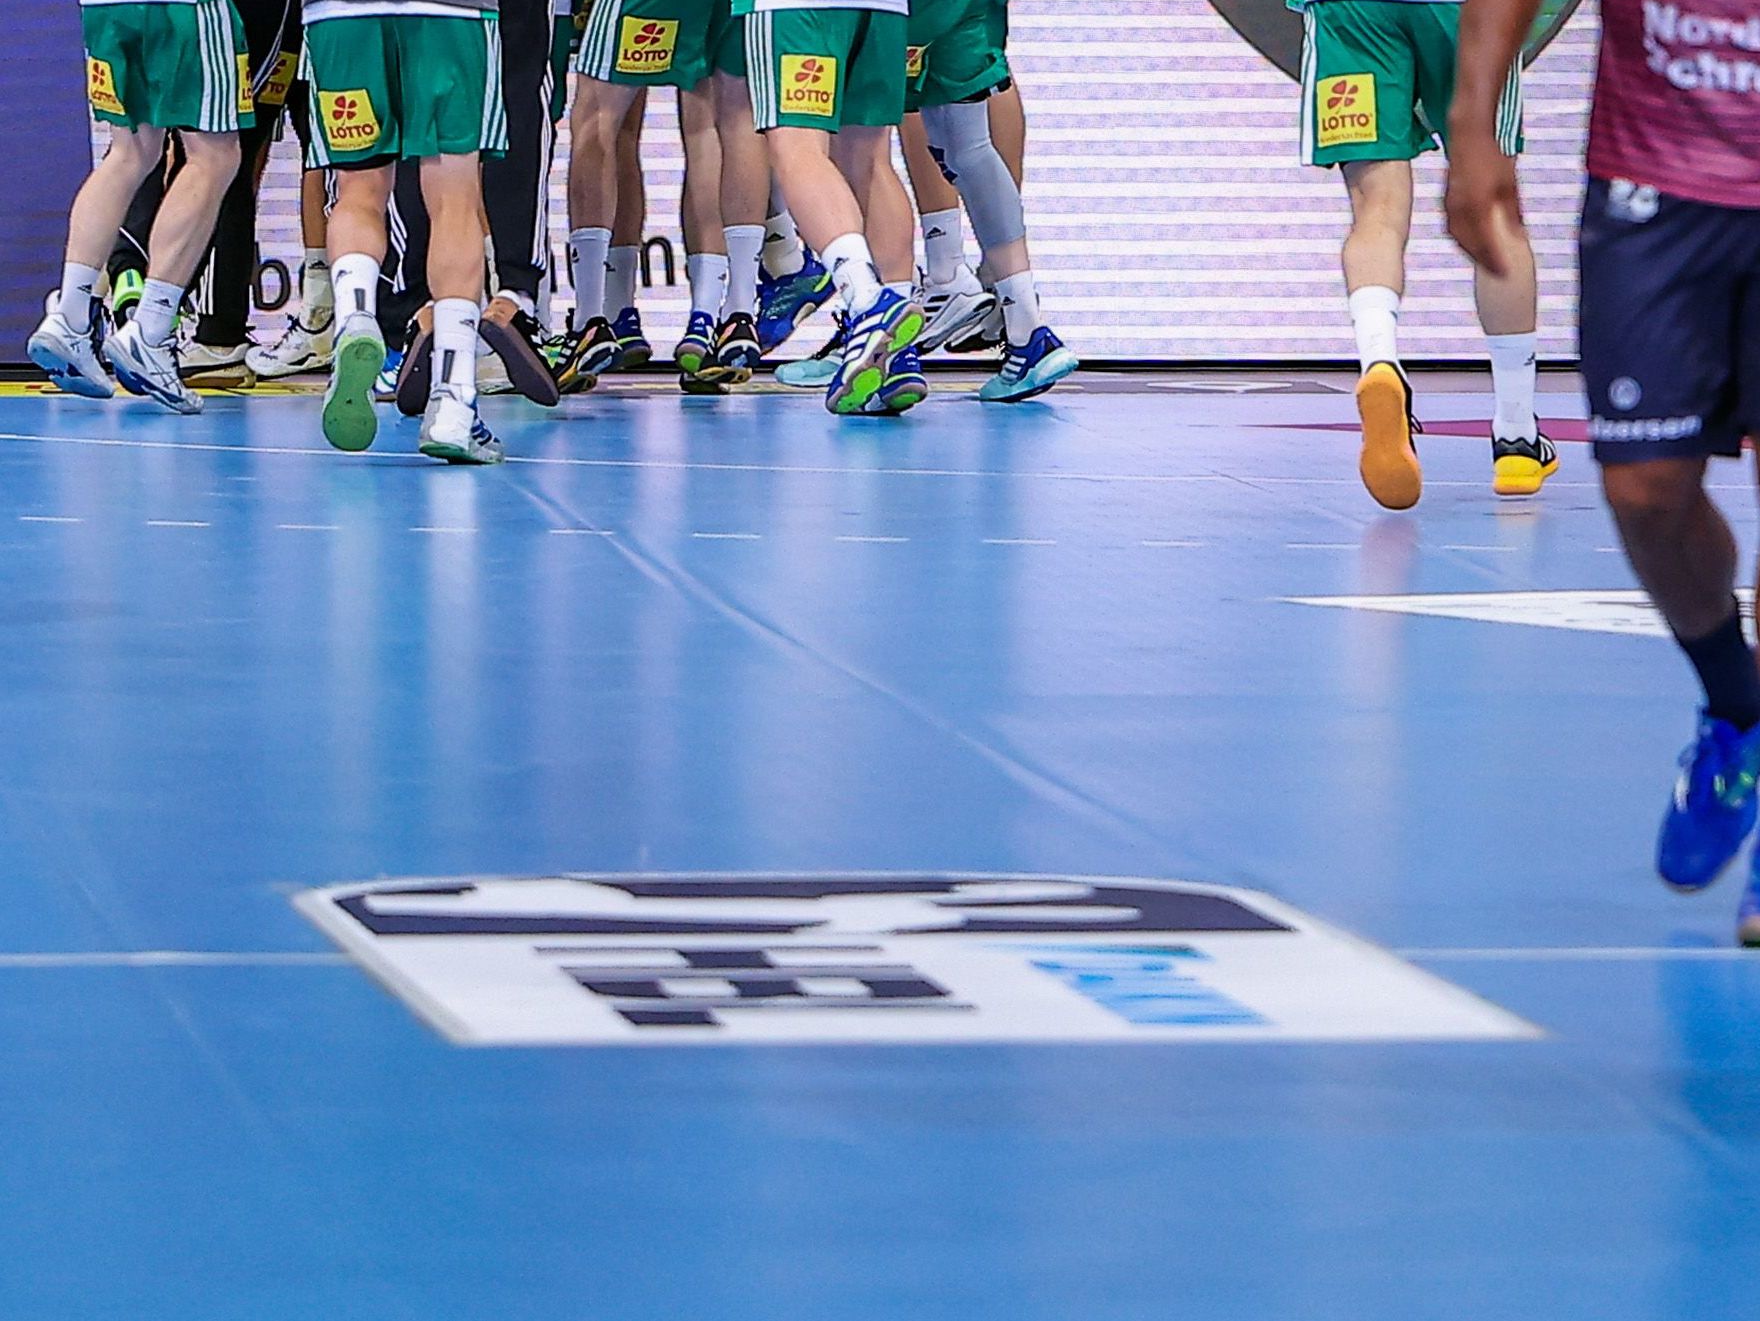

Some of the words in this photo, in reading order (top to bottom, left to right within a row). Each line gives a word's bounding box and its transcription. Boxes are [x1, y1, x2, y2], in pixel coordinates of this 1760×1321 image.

[623, 47, 669, 63] LOTTO
[90, 89, 118, 105] LOTTO
[786, 88, 830, 103] LOTTO
[1321, 113, 1370, 132] LOTTO
[328, 124, 375, 140] LOTTO
